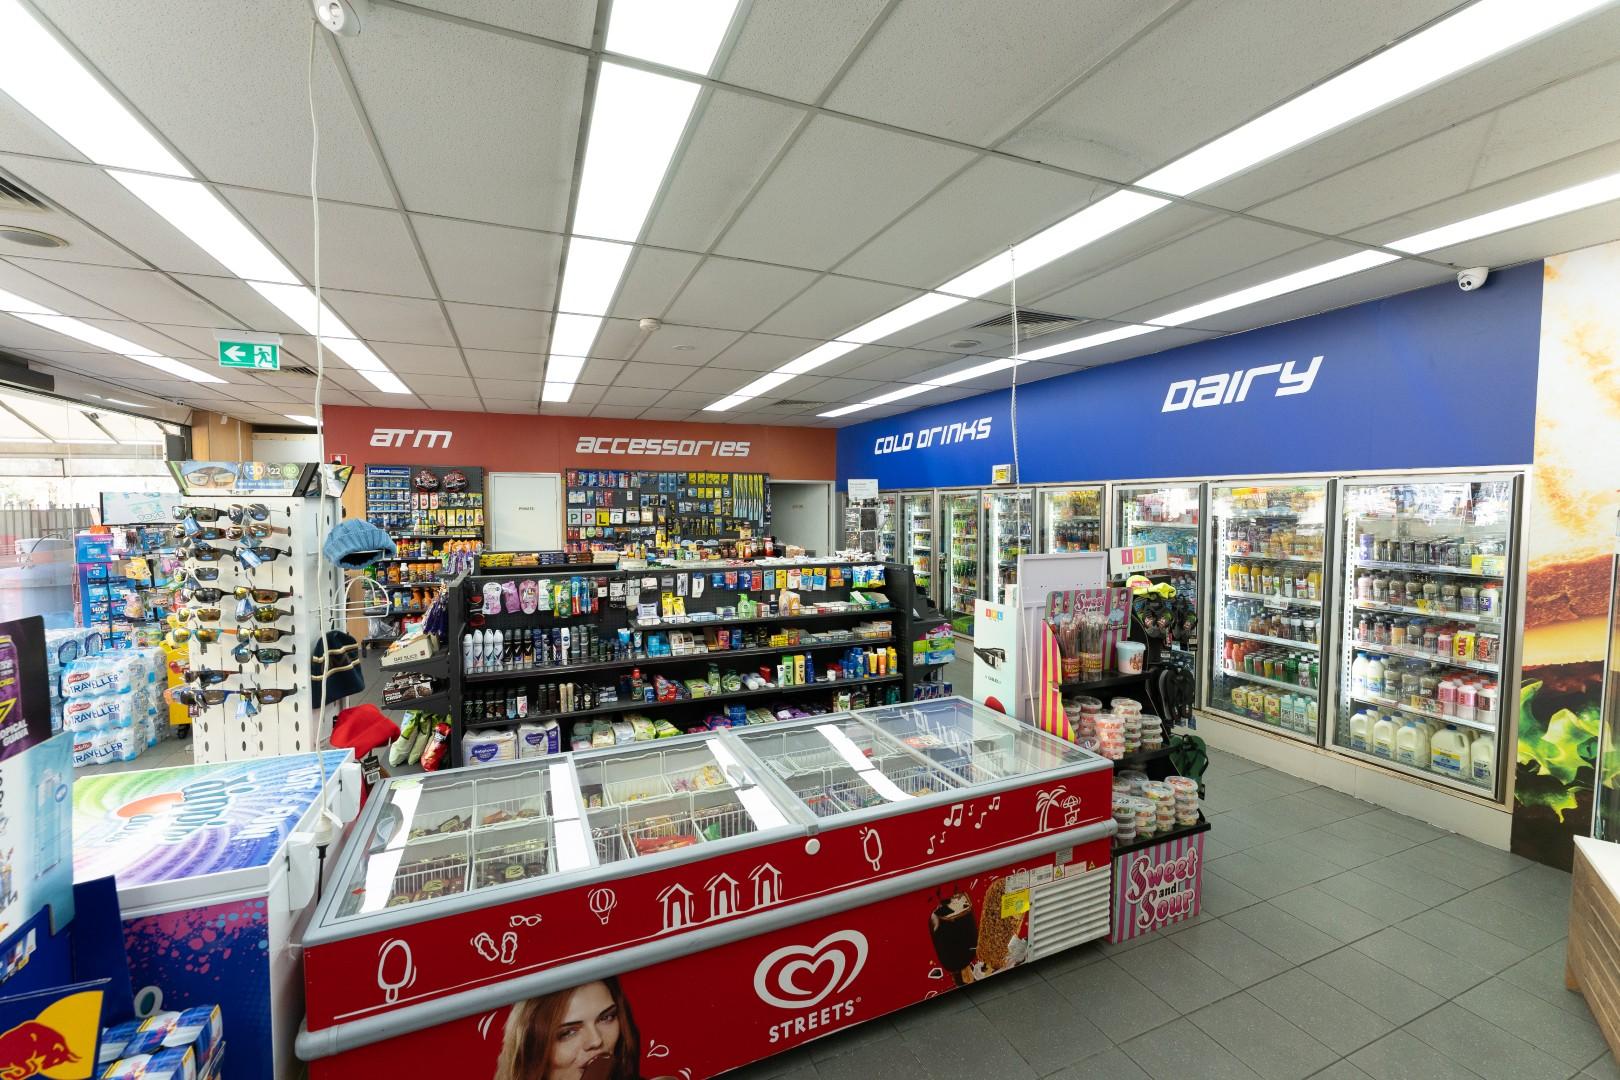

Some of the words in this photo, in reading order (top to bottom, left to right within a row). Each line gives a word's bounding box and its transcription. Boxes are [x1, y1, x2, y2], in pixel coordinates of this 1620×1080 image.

[874, 432, 914, 455] COLD
[70, 674, 120, 692] TRAVELLER
[71, 703, 120, 722] TRAVELLER
[2, 727, 29, 747] GUAVA
[1126, 847, 1198, 902] Sweet
[1158, 882, 1177, 898] and
[1137, 889, 1194, 928] Sour
